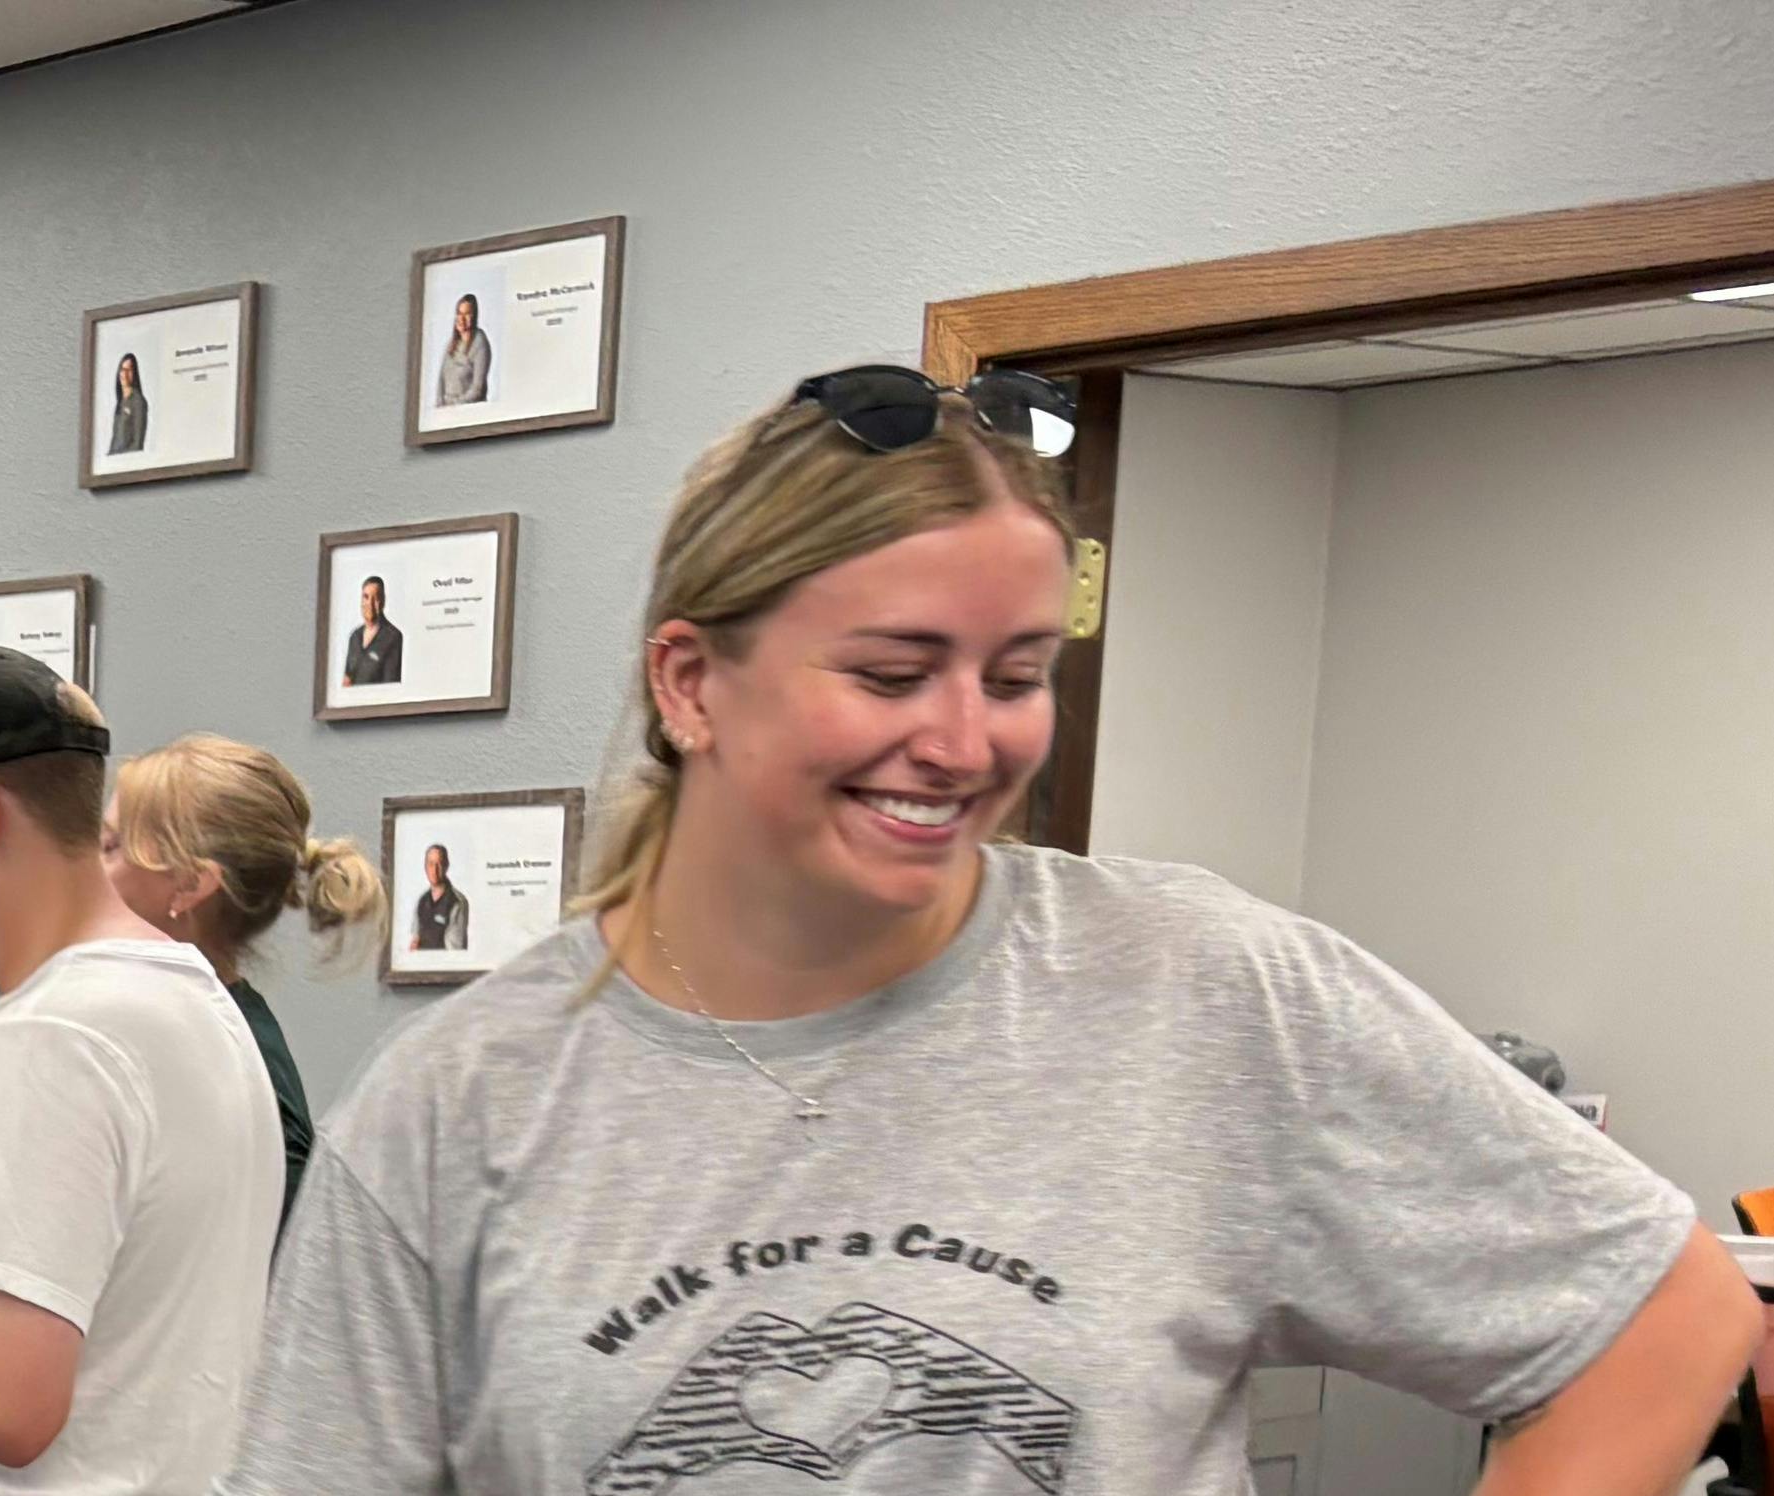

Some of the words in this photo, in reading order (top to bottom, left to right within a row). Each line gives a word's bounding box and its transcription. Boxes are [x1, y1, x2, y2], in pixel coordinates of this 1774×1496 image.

[582, 1262, 713, 1357] Walk
[724, 1235, 821, 1277] for
[842, 1230, 871, 1258] a
[893, 1223, 1066, 1305] Cause
